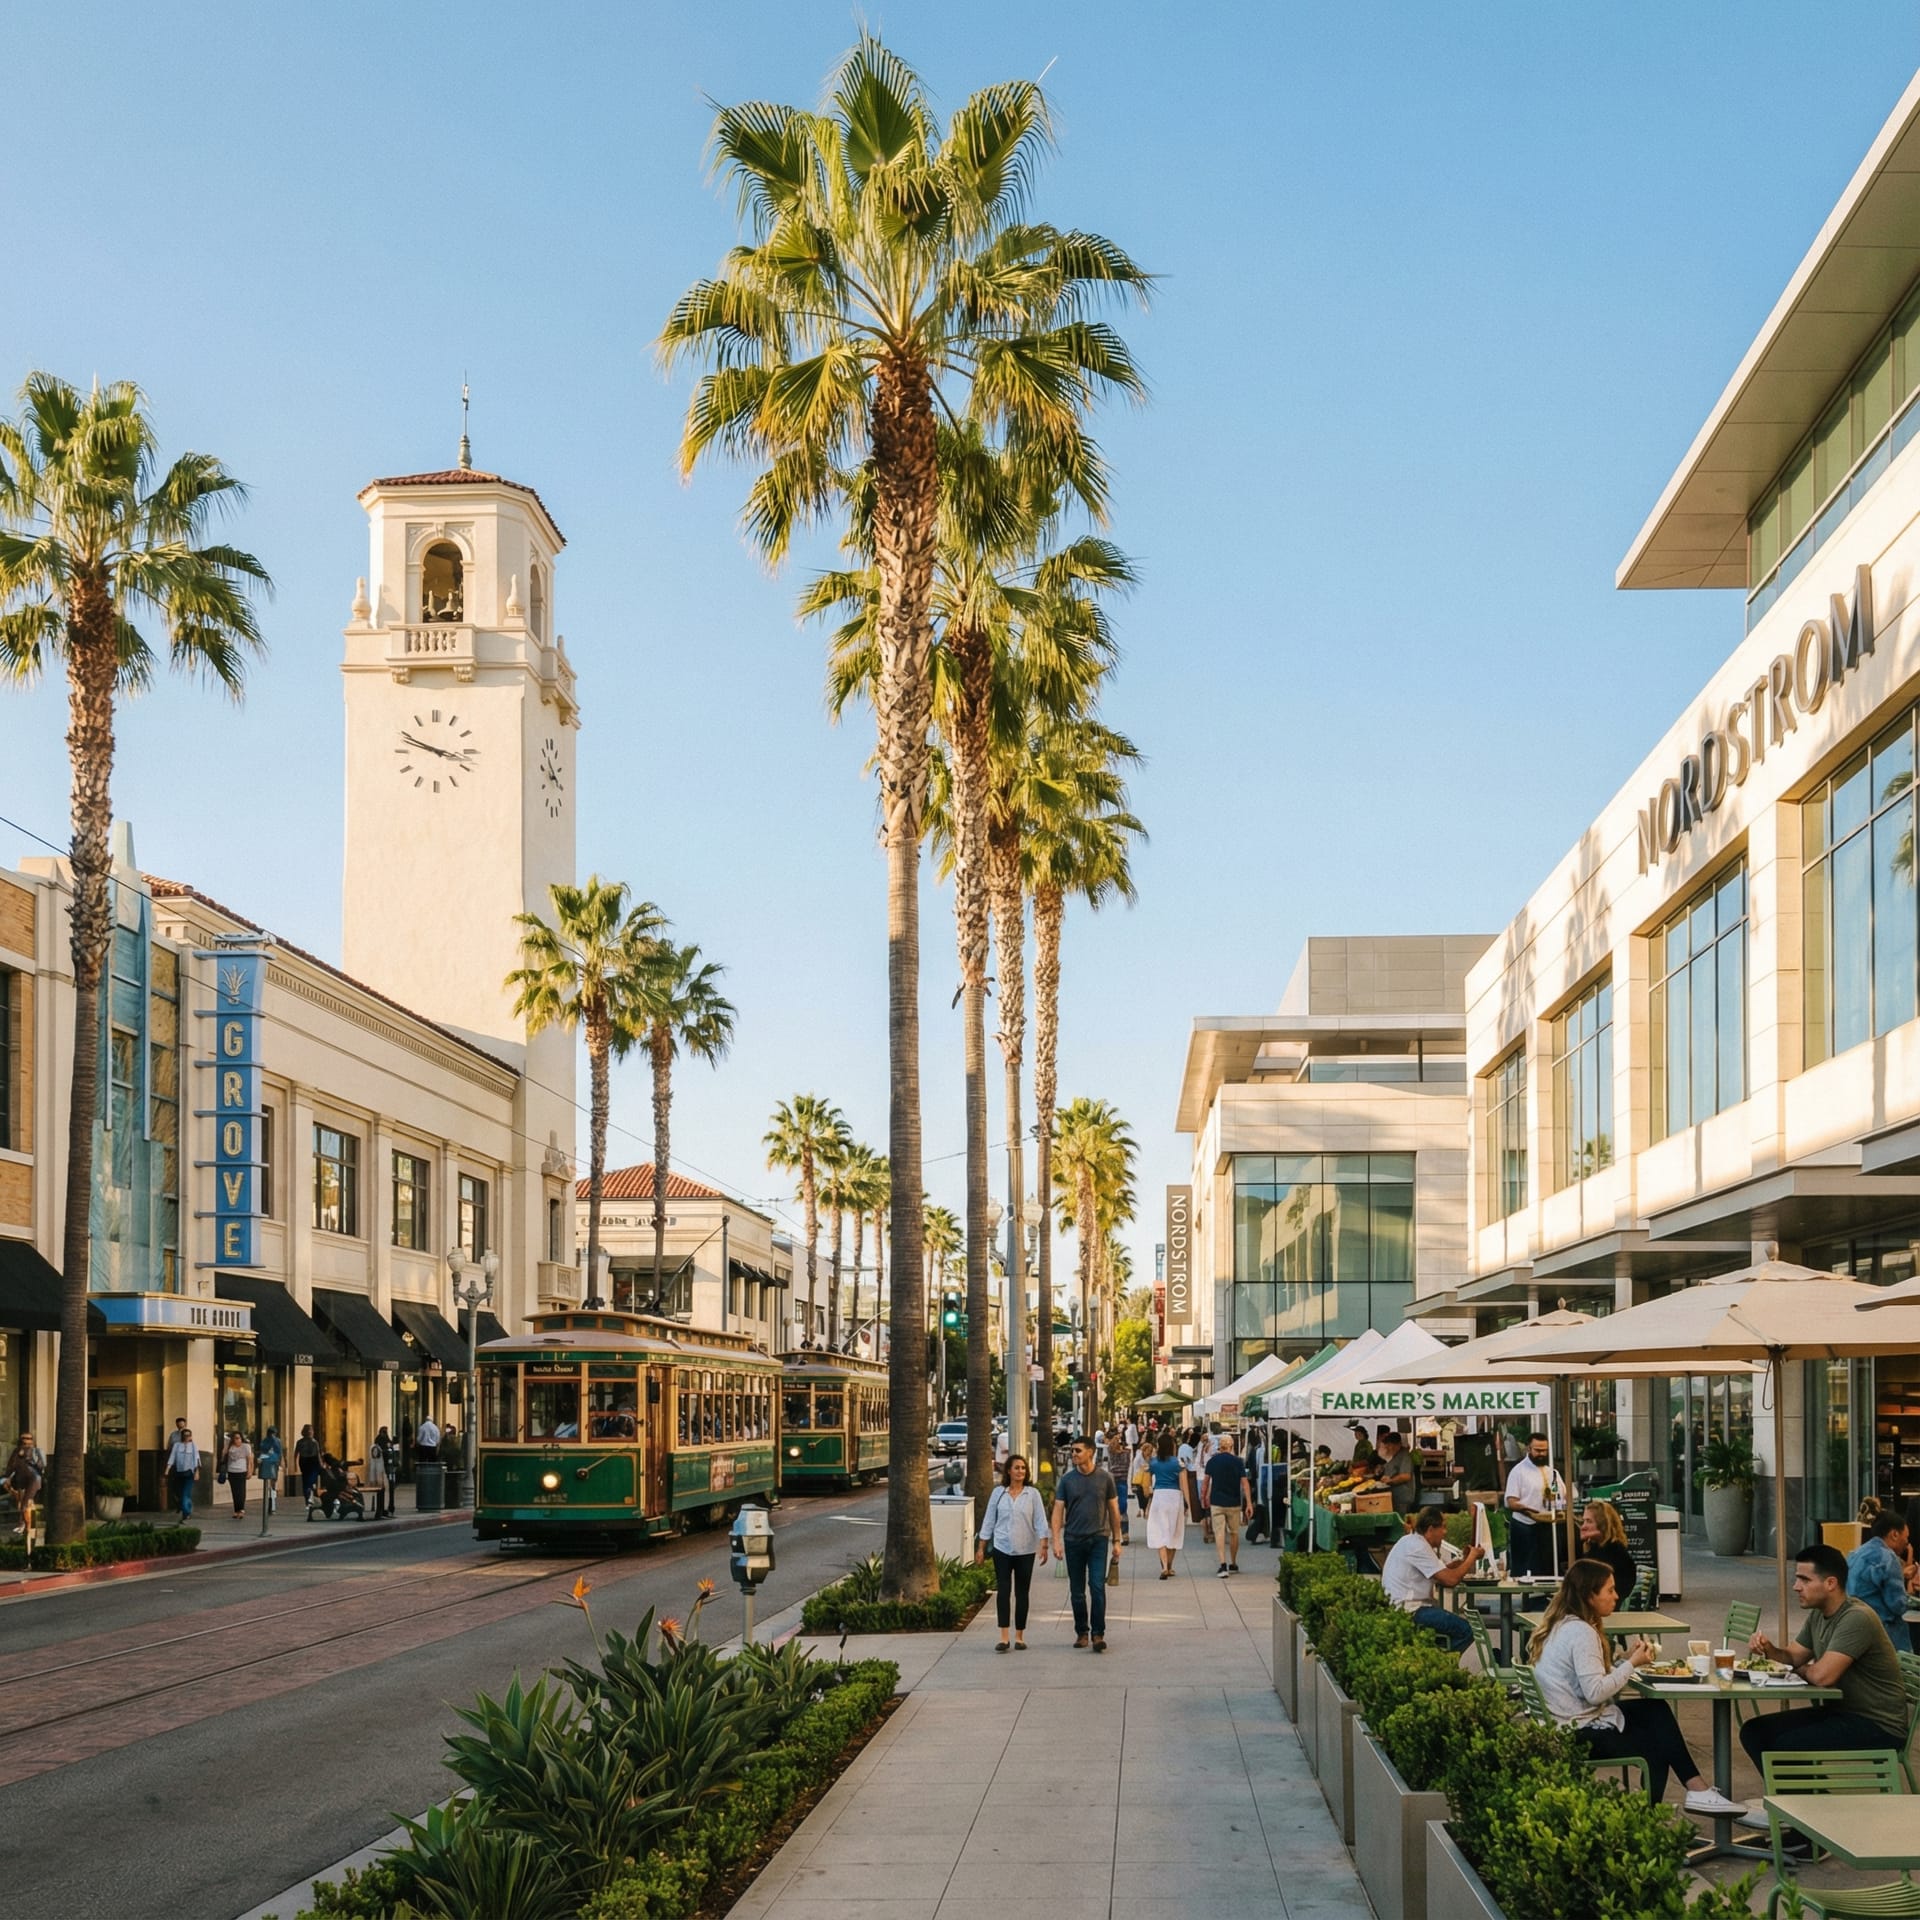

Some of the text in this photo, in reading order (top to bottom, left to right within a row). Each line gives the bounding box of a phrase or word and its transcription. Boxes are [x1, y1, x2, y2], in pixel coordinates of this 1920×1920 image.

[1638, 564, 1874, 877] NORDSTROM
[223, 1021, 244, 1257] GROVE
[1171, 1194, 1187, 1314] NORDSTROM
[1322, 1391, 1540, 1410] FARMER'S MARKET
